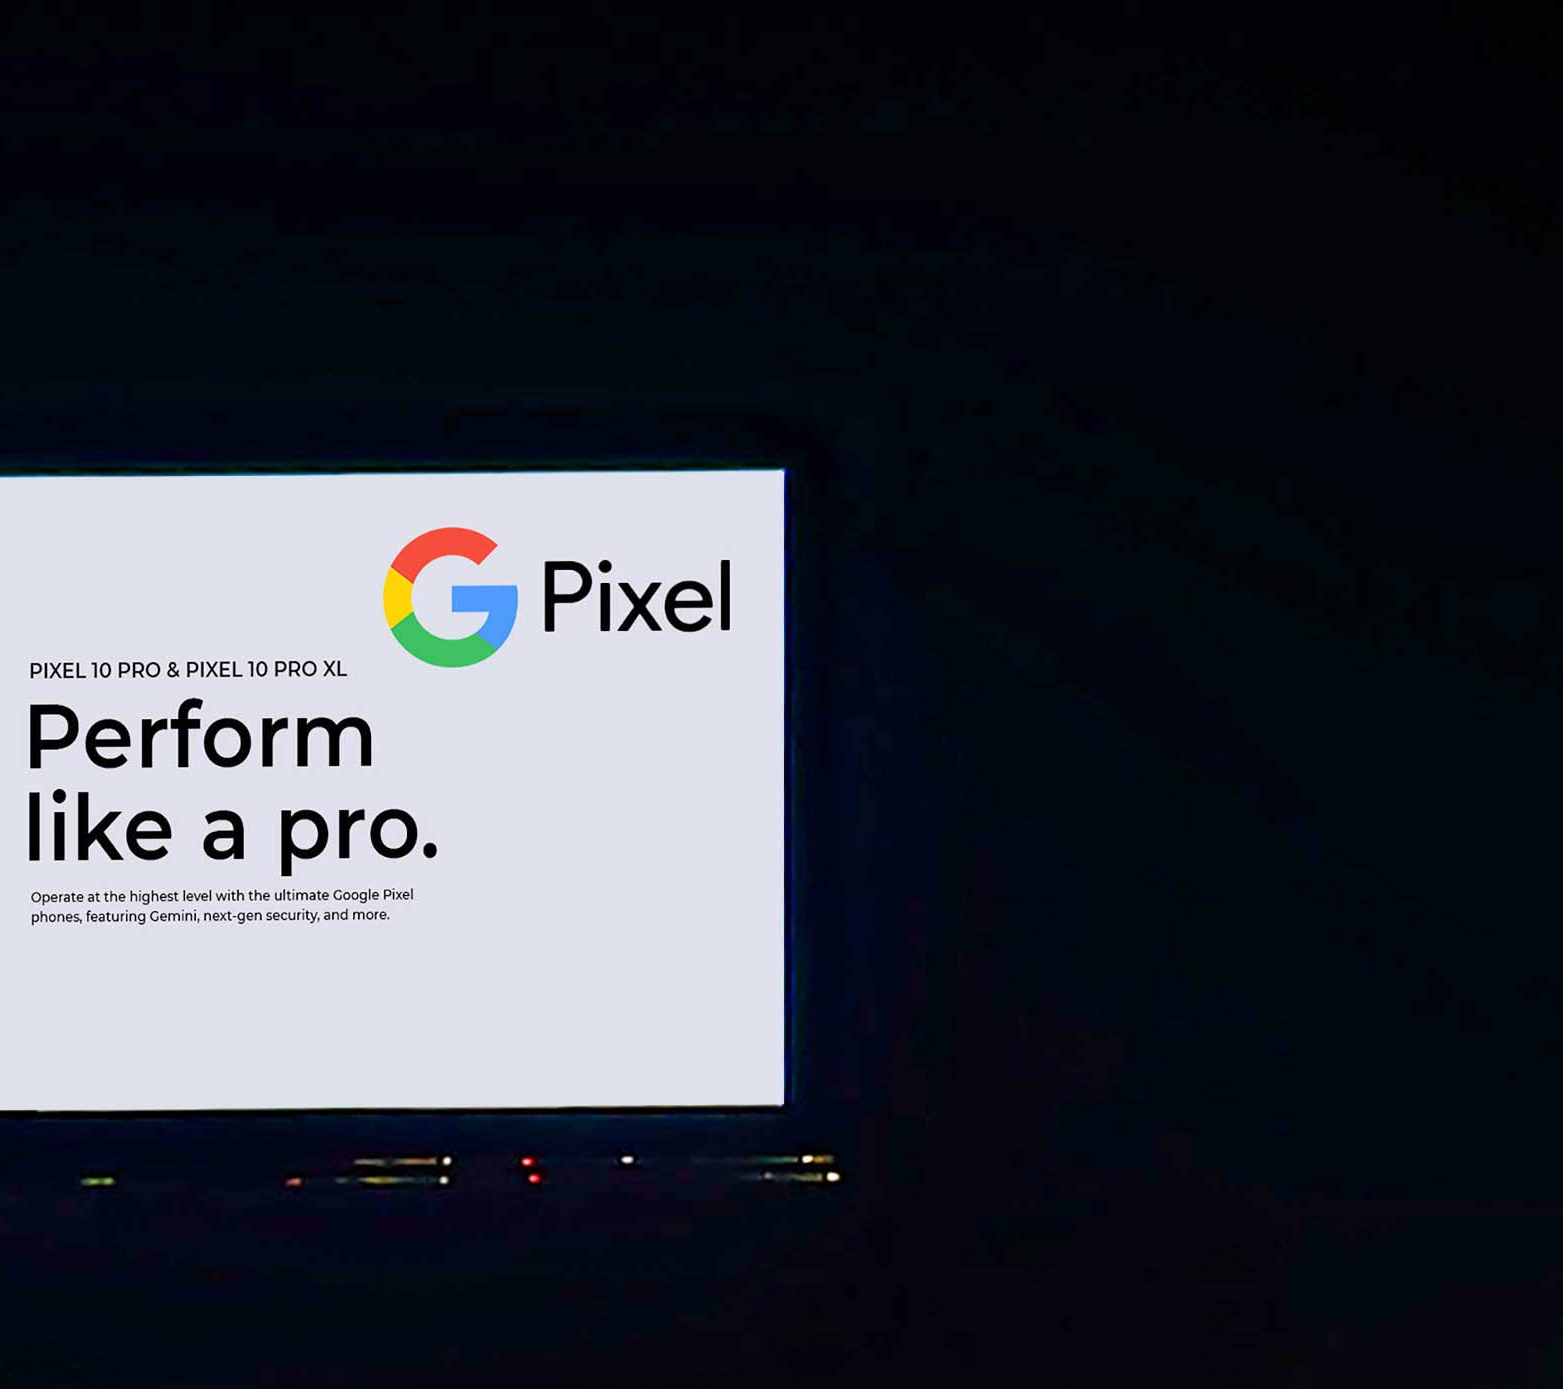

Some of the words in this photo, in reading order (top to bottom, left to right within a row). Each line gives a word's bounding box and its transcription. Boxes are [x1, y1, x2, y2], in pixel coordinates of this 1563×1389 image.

[543, 560, 731, 633] Pixel
[31, 662, 86, 679] PIXEL
[91, 662, 111, 678] 10
[119, 662, 160, 678] PRO
[167, 662, 179, 677] &
[187, 661, 243, 677] PIXEL
[248, 661, 267, 677] 10
[275, 661, 317, 677] PRO
[323, 661, 347, 676] XL
[29, 697, 372, 770] Perform
[28, 788, 173, 862] like
[202, 809, 245, 861] a
[280, 808, 438, 877] pro.
[31, 891, 83, 906] Operate
[88, 892, 100, 903] at
[104, 890, 126, 903] the
[130, 889, 178, 906] highest
[183, 889, 211, 902] level
[216, 889, 244, 902] with
[249, 889, 270, 902] the
[275, 888, 329, 902] ultimate
[333, 888, 379, 904] Google
[384, 887, 413, 901] Pixel
[32, 910, 82, 926] phones,
[86, 909, 145, 926] featuring
[150, 908, 199, 924] Gemini,
[204, 911, 262, 925] next-gen
[266, 908, 320, 924] security,
[324, 908, 348, 921] and
[353, 910, 389, 921] more.
